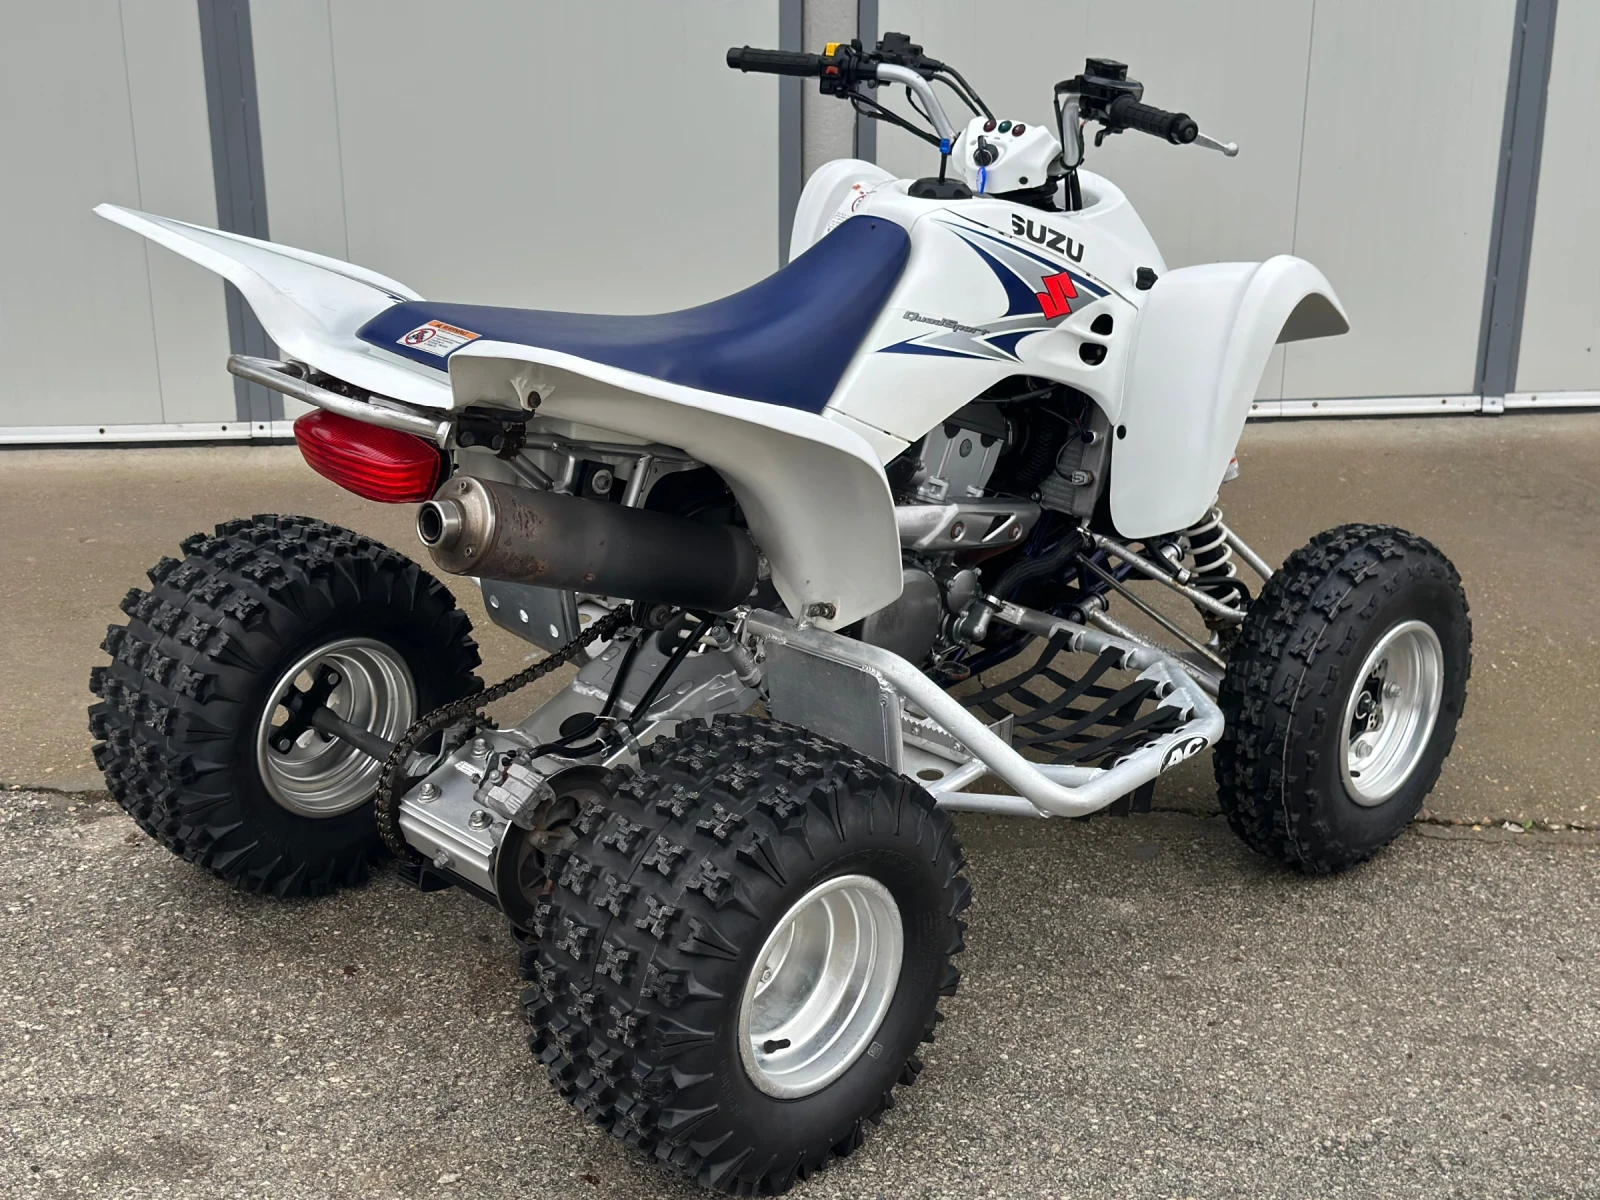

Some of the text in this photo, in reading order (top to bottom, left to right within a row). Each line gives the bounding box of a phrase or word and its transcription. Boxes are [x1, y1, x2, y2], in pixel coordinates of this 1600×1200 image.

[1012, 213, 1084, 263] SUZU
[902, 311, 990, 335] QuadSport
[1163, 737, 1203, 768] AC
